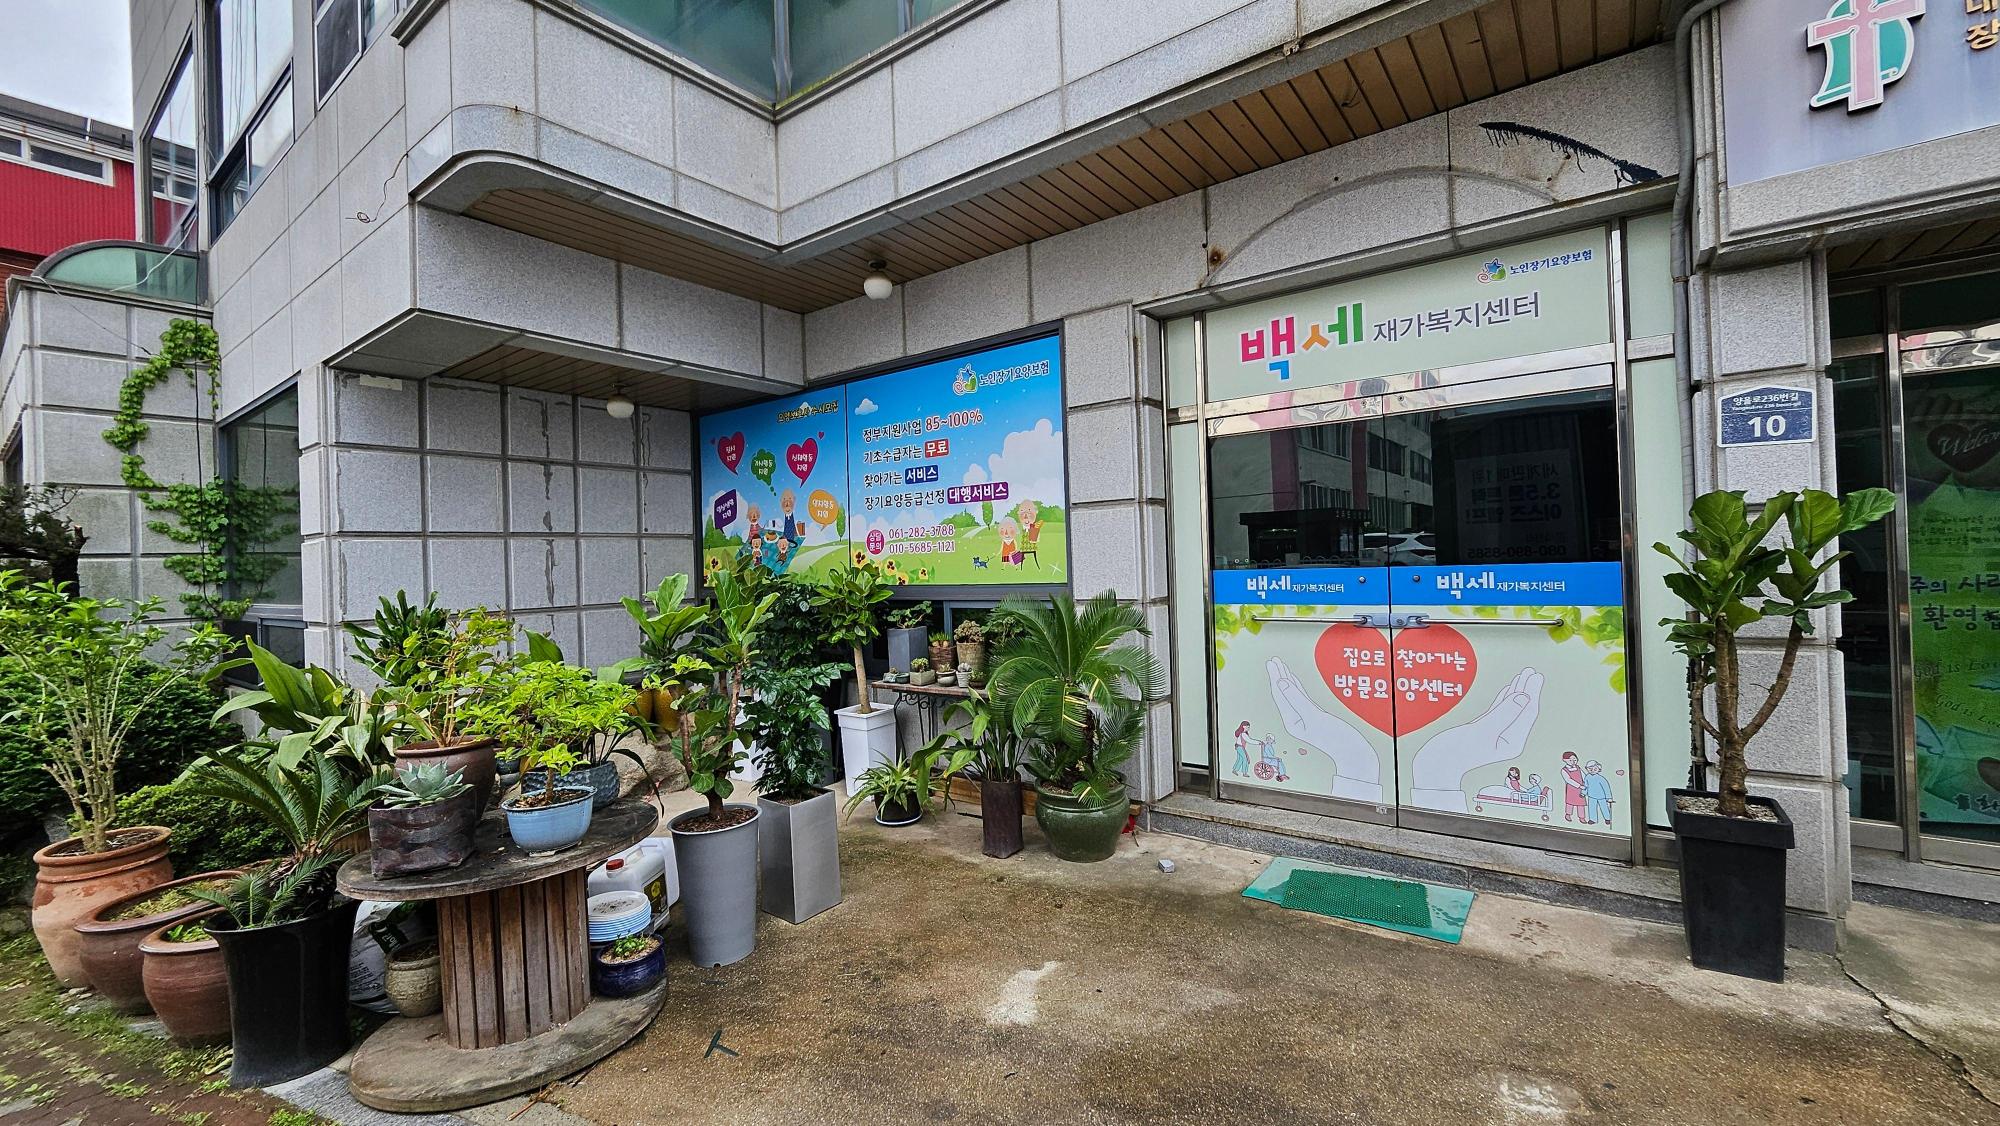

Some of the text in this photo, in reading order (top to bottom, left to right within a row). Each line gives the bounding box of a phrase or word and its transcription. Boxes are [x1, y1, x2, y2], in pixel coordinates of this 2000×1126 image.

[1510, 249, 1592, 276] 노인장기요양보험
[1241, 292, 1540, 380] 백세 재가복지센터
[979, 360, 1050, 387] 노인장기요양보험
[1732, 392, 1799, 406] 양을로236번길
[863, 409, 983, 443] 정부지원사업 85~100%
[1748, 415, 1787, 438] 10
[863, 440, 948, 464] 기초수급자는 무료
[864, 467, 938, 488] 찾아가는 서비스
[864, 484, 1008, 510] 장기요양등급선정 대행서비스
[868, 532, 882, 542] 상담
[889, 525, 954, 539] 061-282-3788
[868, 541, 882, 551] 문의
[889, 541, 955, 554] 010-5685-1121
[1247, 574, 1344, 600] 백세 재가복지센터
[1436, 571, 1565, 600] 백세 재가복지센터
[1343, 647, 1467, 672] 집으로 찾아가는
